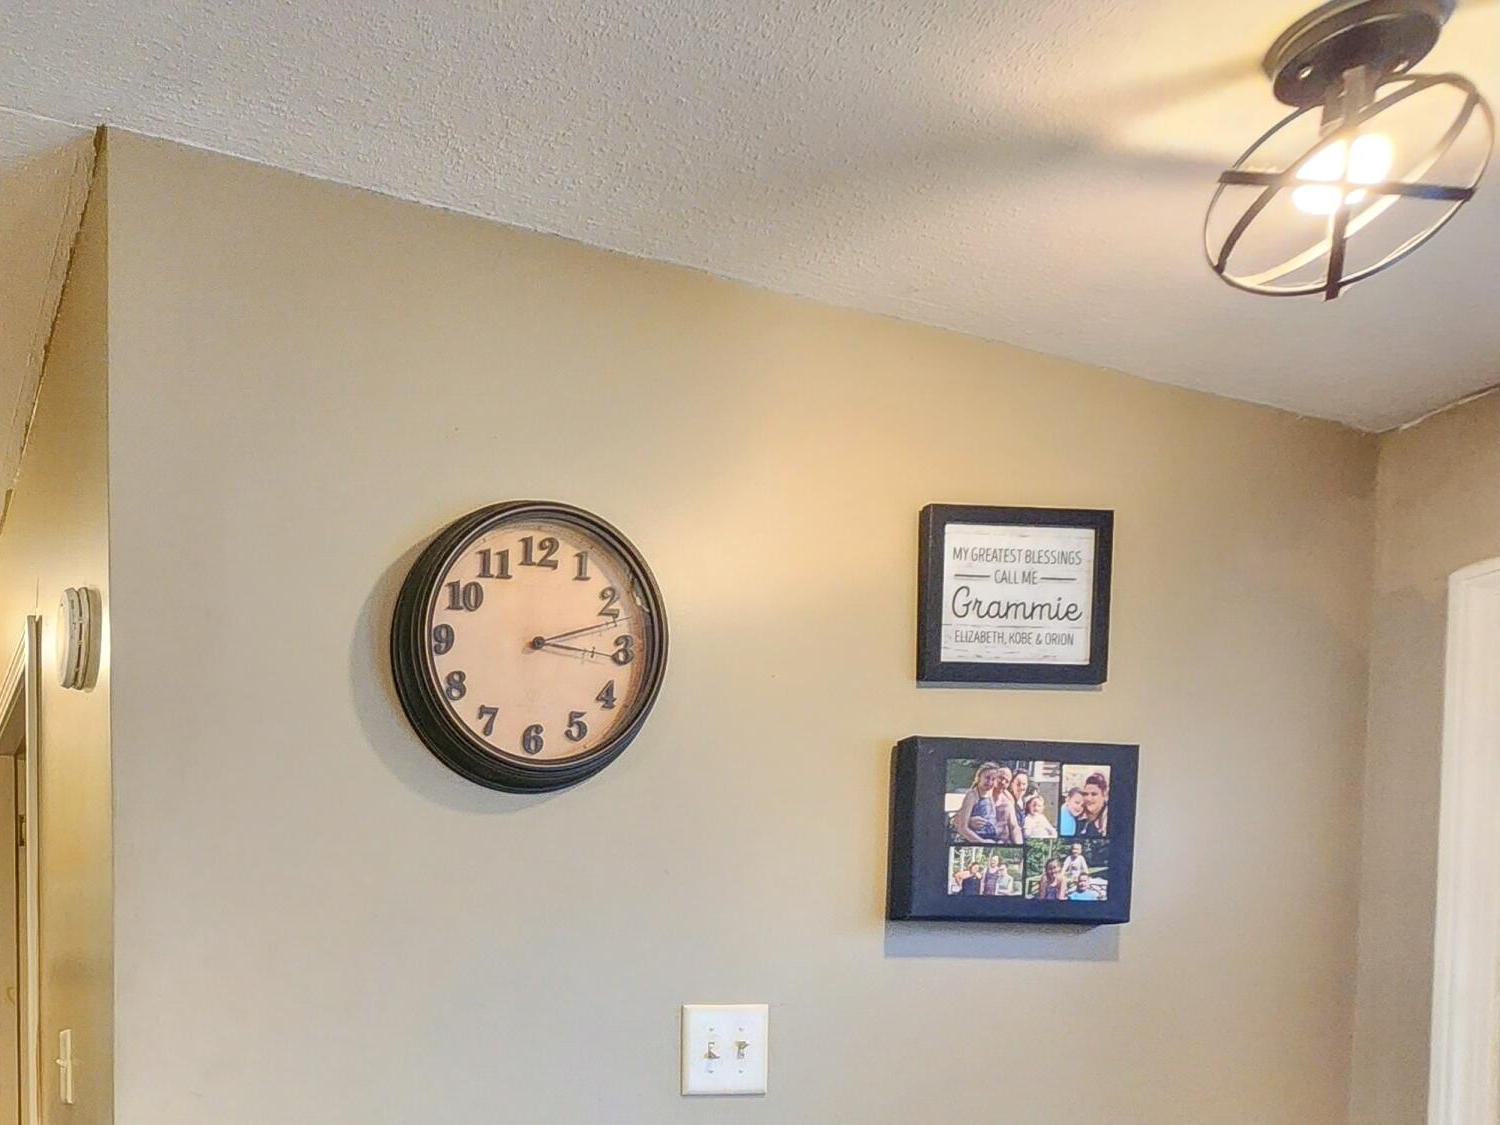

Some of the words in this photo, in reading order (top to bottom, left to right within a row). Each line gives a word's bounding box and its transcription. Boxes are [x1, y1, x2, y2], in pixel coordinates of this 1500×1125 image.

[477, 549, 513, 579] 11
[518, 536, 560, 570] 12
[573, 551, 590, 581] 1
[953, 547, 969, 560] MY
[971, 547, 1023, 563] GREATEST
[1025, 549, 1082, 565] BLESSINGS
[994, 569, 1019, 584] CALL
[1021, 570, 1038, 585] ME
[445, 580, 484, 612] 10
[598, 587, 620, 617] 2
[952, 586, 1083, 621] Grammie
[433, 624, 455, 656] 9
[612, 635, 634, 665] 3
[955, 630, 1007, 644] ELIZABETH,
[1009, 632, 1033, 644] KOBE
[1036, 634, 1042, 644] &
[1045, 633, 1074, 645] ORION
[444, 670, 466, 701] 8
[596, 679, 616, 710] 4
[478, 705, 499, 736] 7
[564, 711, 588, 742] 5
[522, 724, 544, 755] 6
